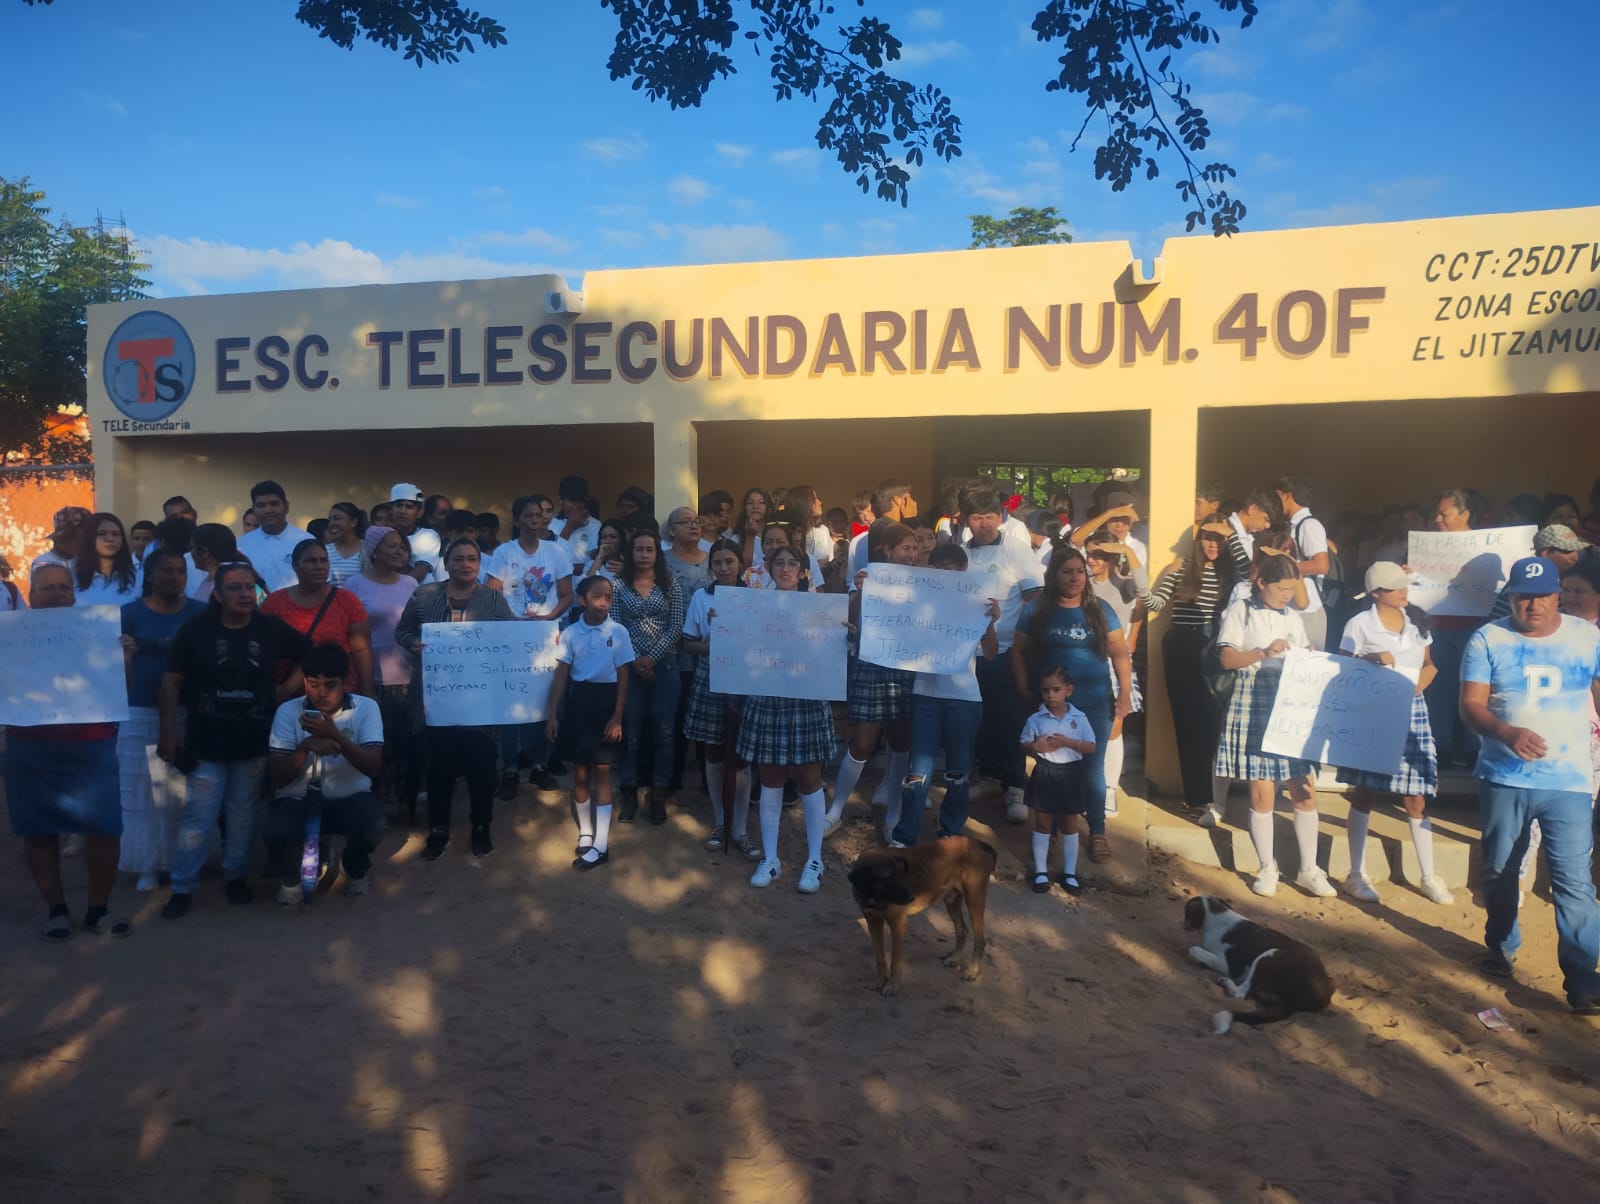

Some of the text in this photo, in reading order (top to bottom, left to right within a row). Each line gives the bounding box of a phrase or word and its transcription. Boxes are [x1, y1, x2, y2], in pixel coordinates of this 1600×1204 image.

[1435, 287, 1600, 321] ZONA ESCO
[215, 334, 340, 394] ESC.
[367, 308, 982, 389] TELESECUNDARIA
[1003, 298, 1199, 374] NUM.
[1412, 336, 1446, 361] EL
[102, 419, 130, 432] TELE
[1523, 664, 1563, 712] P
